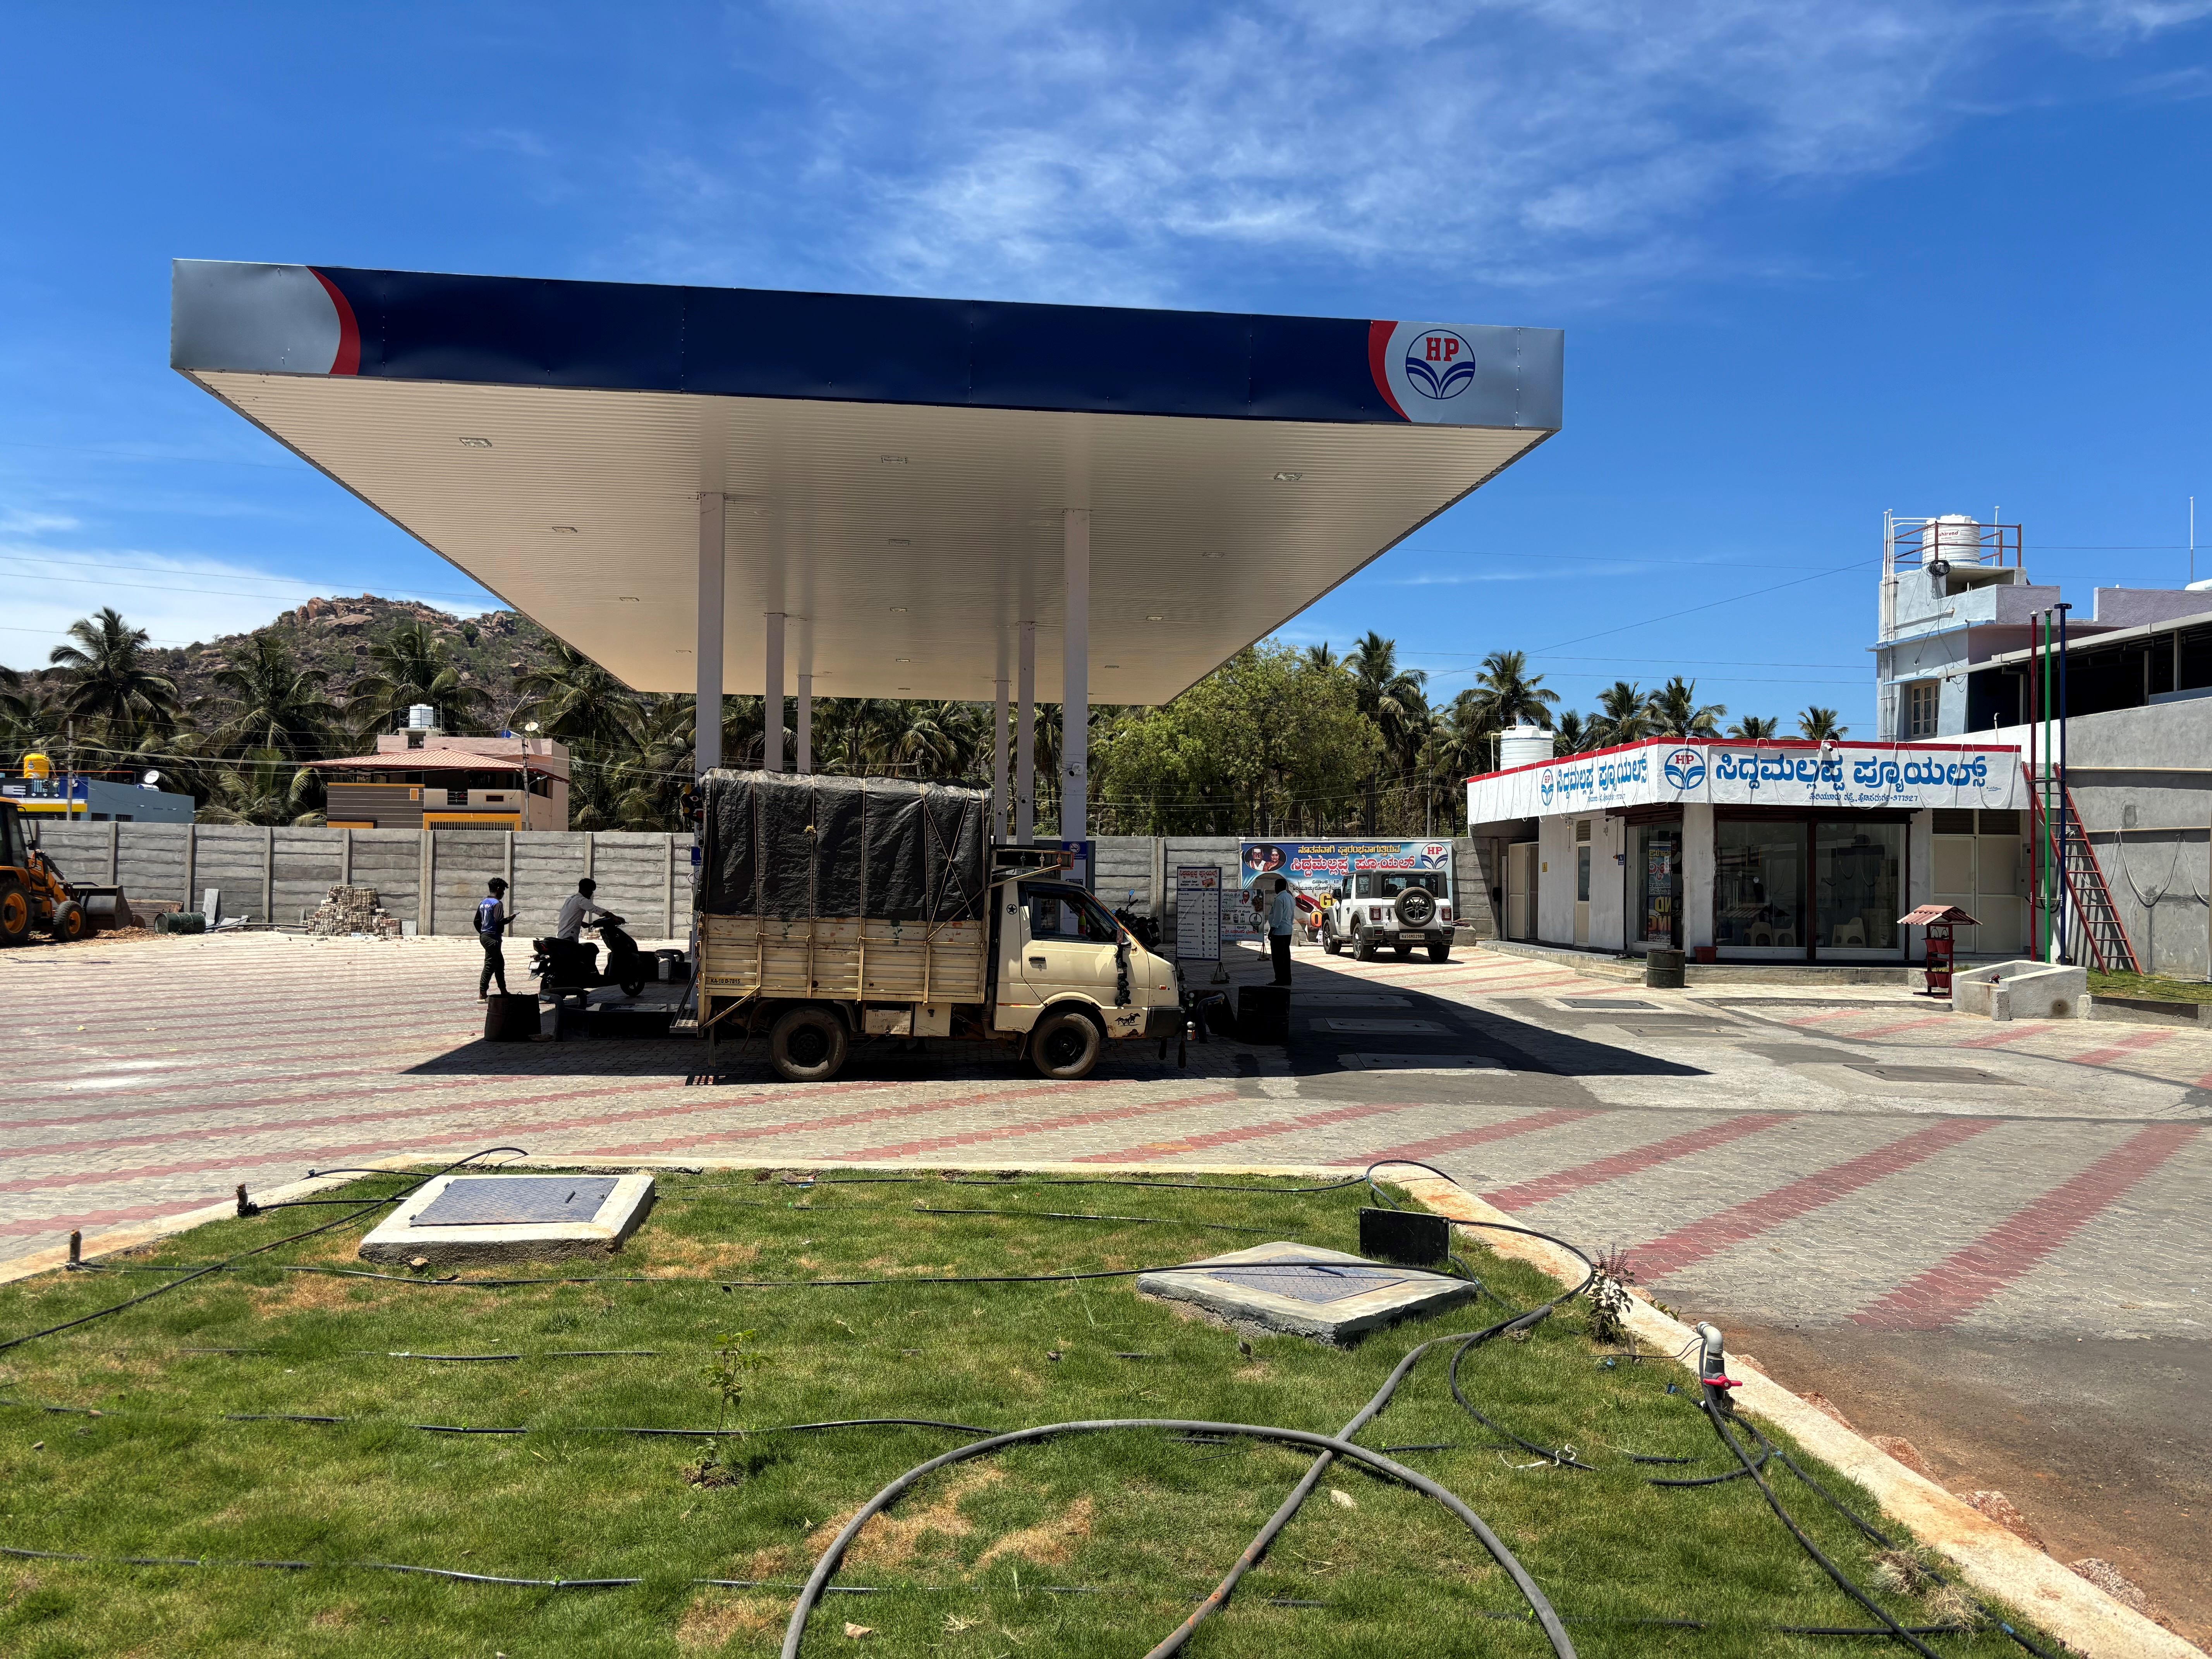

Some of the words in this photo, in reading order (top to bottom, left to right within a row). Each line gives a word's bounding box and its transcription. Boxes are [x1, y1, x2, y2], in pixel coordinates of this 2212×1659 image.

[1425, 337, 1459, 362] HP
[1675, 755, 1694, 764] HP
[1427, 847, 1443, 855] HP
